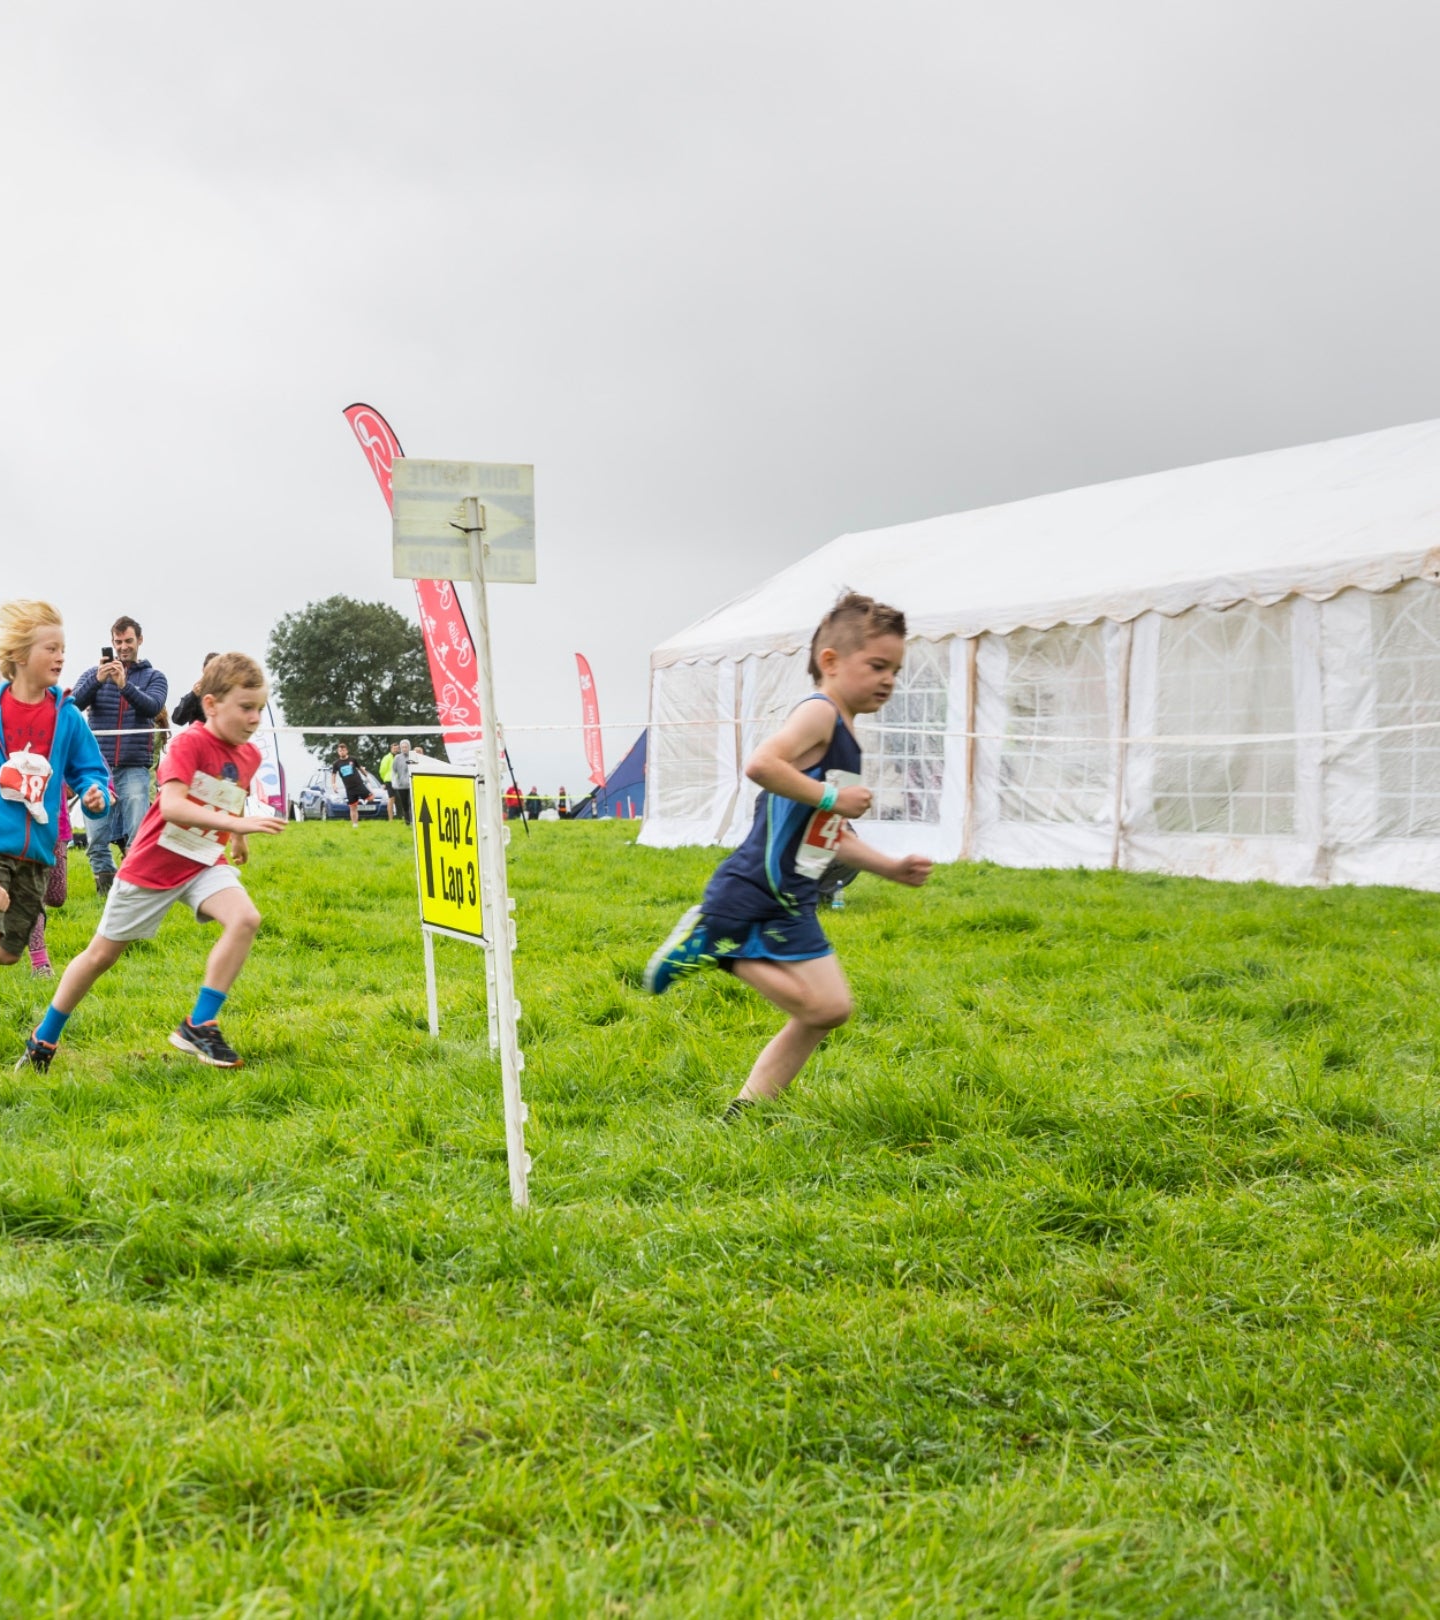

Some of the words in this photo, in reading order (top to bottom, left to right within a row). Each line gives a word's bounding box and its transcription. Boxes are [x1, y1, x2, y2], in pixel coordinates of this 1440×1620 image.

[437, 798, 461, 850] Lap
[464, 800, 473, 846] 2
[819, 813, 843, 851] 4
[440, 856, 464, 909] Lap
[468, 861, 477, 906] 3
